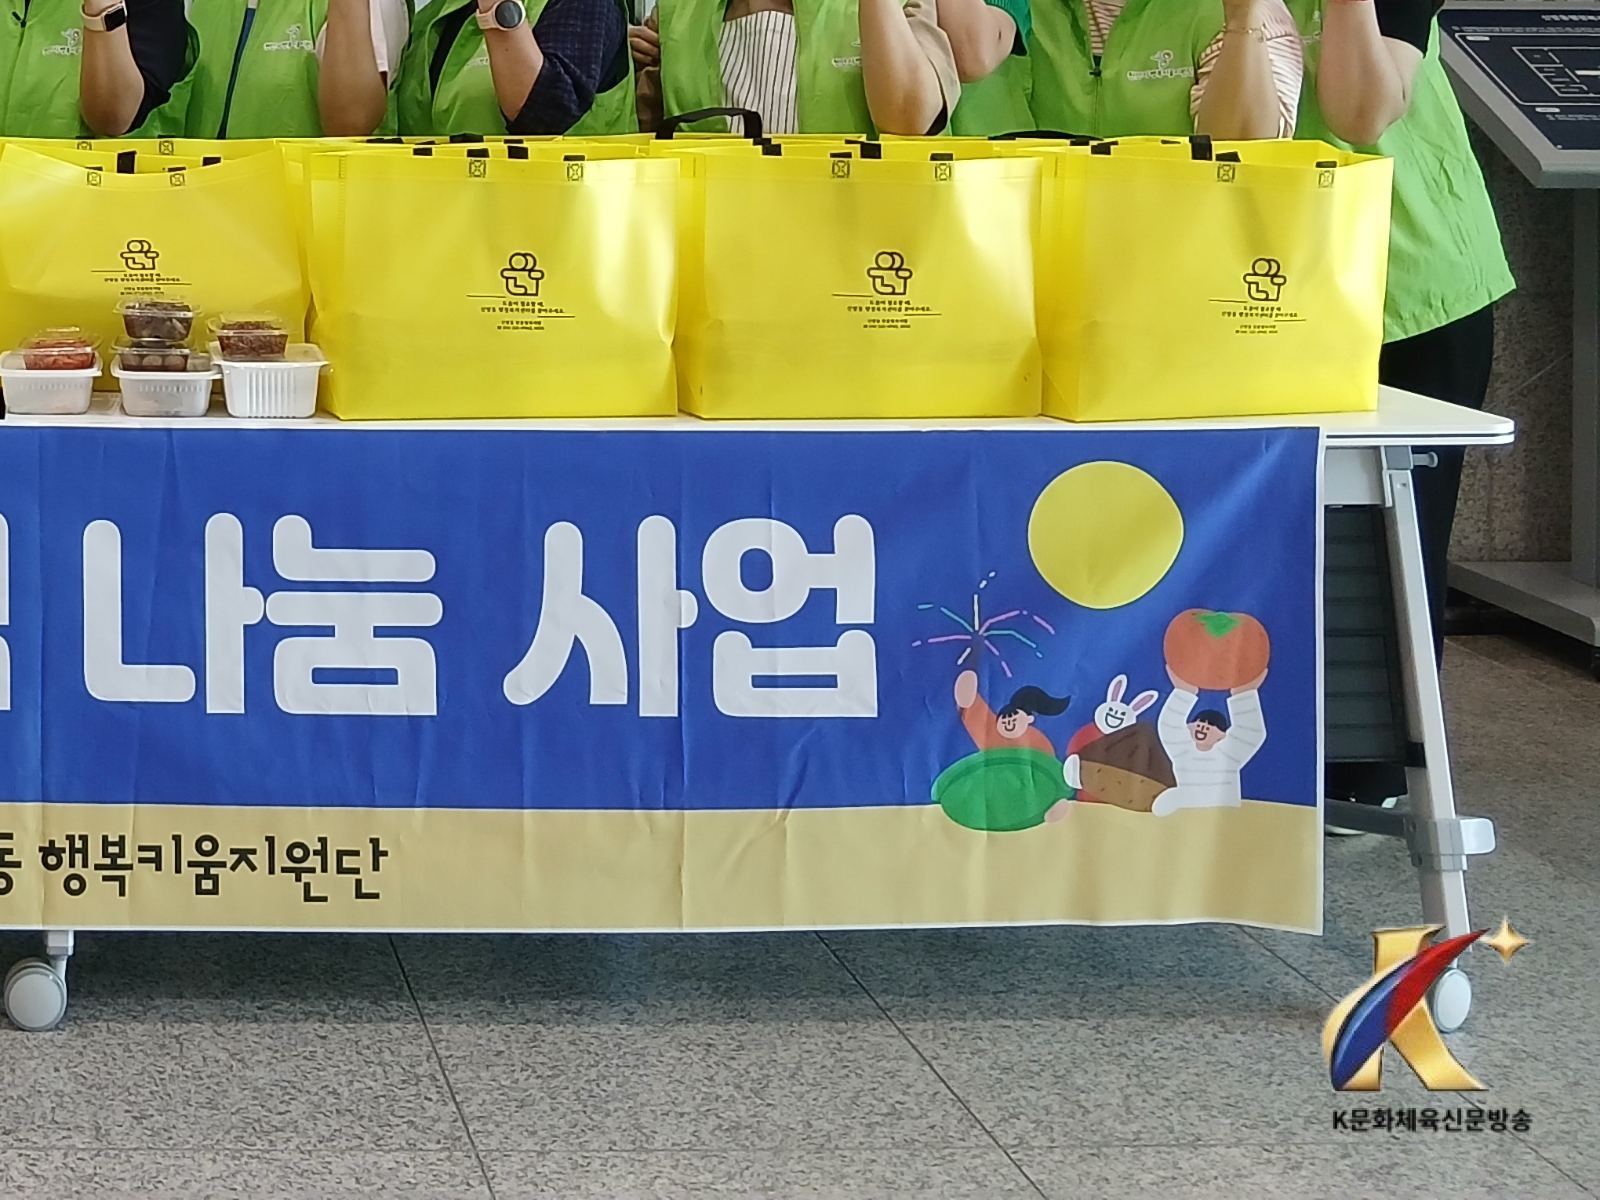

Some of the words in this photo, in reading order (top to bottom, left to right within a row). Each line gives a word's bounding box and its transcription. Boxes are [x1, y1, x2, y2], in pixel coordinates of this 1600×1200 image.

[82, 512, 444, 715] 나눔
[502, 514, 879, 718] 사업
[38, 833, 388, 902] 행복키움지원단
